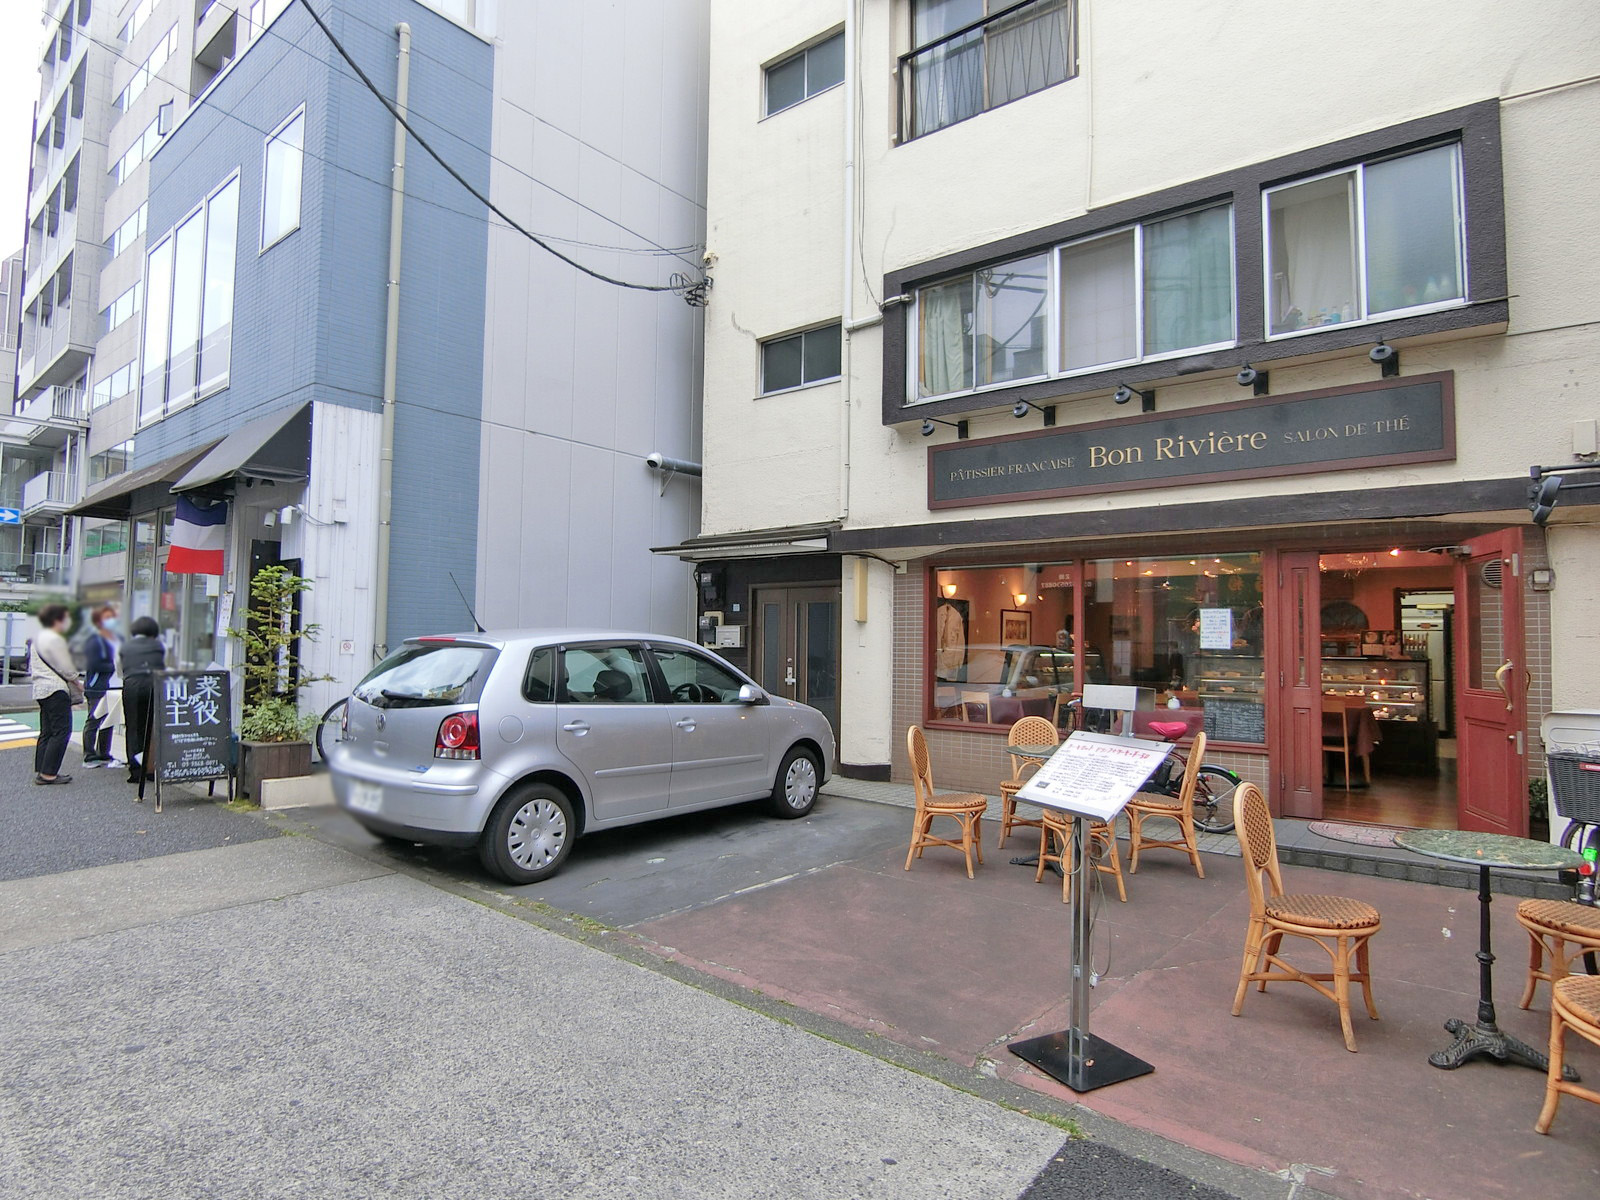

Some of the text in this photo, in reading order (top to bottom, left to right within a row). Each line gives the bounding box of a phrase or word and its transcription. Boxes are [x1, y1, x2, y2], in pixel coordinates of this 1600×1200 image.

[1283, 414, 1410, 444] SALON DE THÉ
[1088, 431, 1267, 468] Bon Rivière
[950, 466, 1005, 481] PÂTISSIER
[165, 700, 221, 726] 主役
